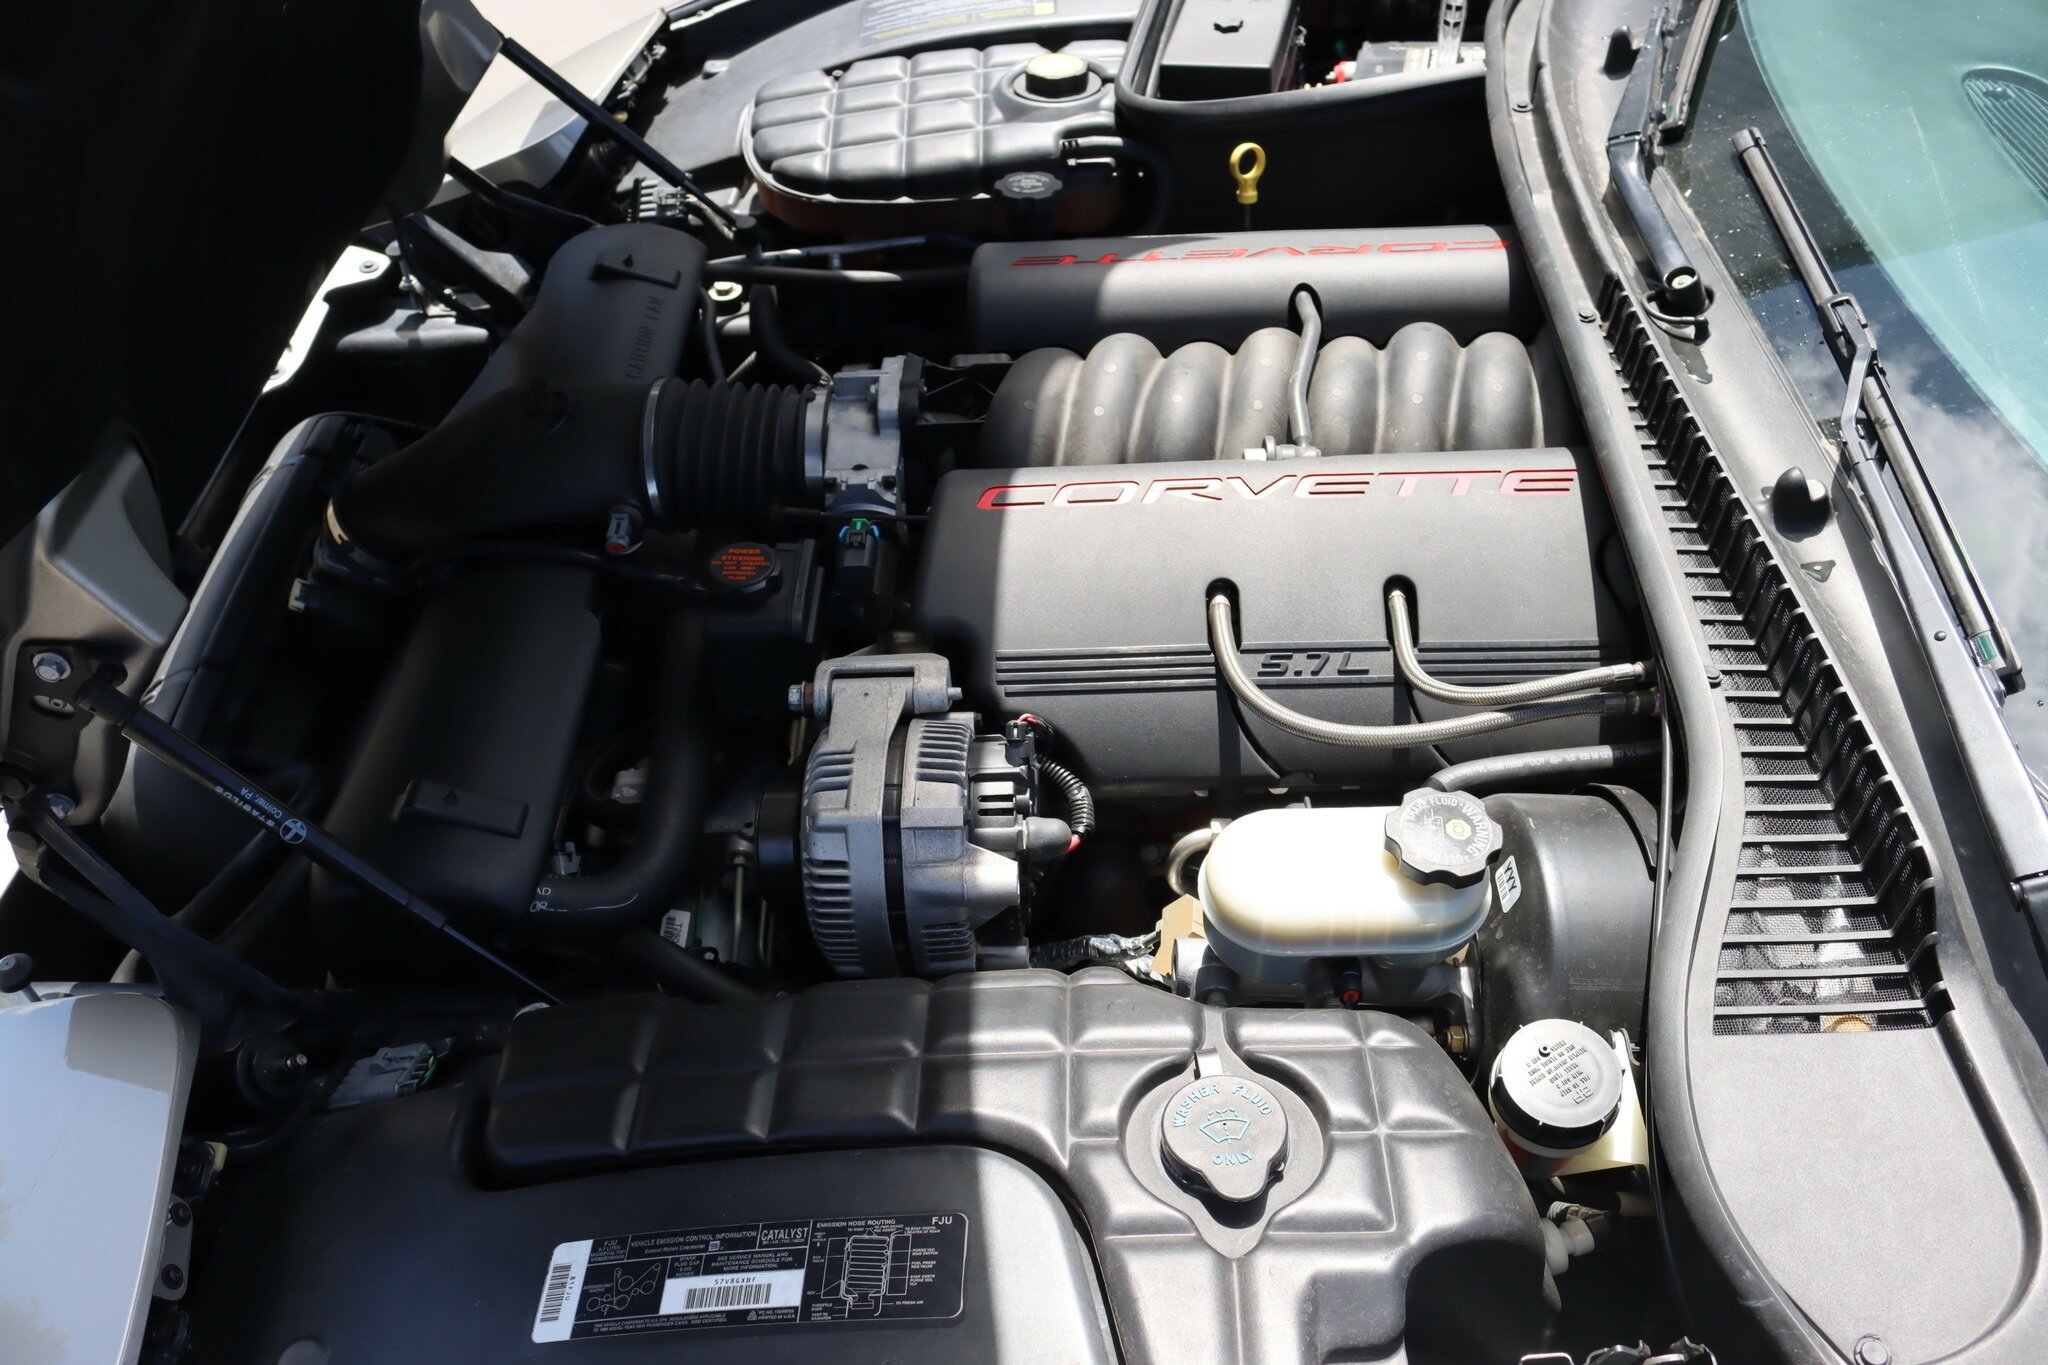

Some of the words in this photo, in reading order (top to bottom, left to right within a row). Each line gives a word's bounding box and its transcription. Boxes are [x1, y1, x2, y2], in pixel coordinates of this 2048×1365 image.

[1010, 240, 1511, 267] CORVETTE
[977, 470, 1578, 509] CORVETTE
[215, 785, 275, 827] STABILUS
[240, 787, 254, 800] PA
[1429, 796, 1458, 807] FLUID
[254, 794, 283, 819] Colmar,
[1461, 803, 1490, 857] WARNING
[1504, 861, 1517, 892] YYY
[1173, 1083, 1222, 1127] WASHER
[1231, 1084, 1272, 1115] FLUID
[1212, 1150, 1253, 1165] ONLY
[932, 1216, 952, 1225] FJU
[656, 1237, 684, 1245] EMISSION
[685, 1234, 713, 1242] CONTROL
[716, 1231, 757, 1239] INFORMATION
[761, 1227, 809, 1240] CATALYST
